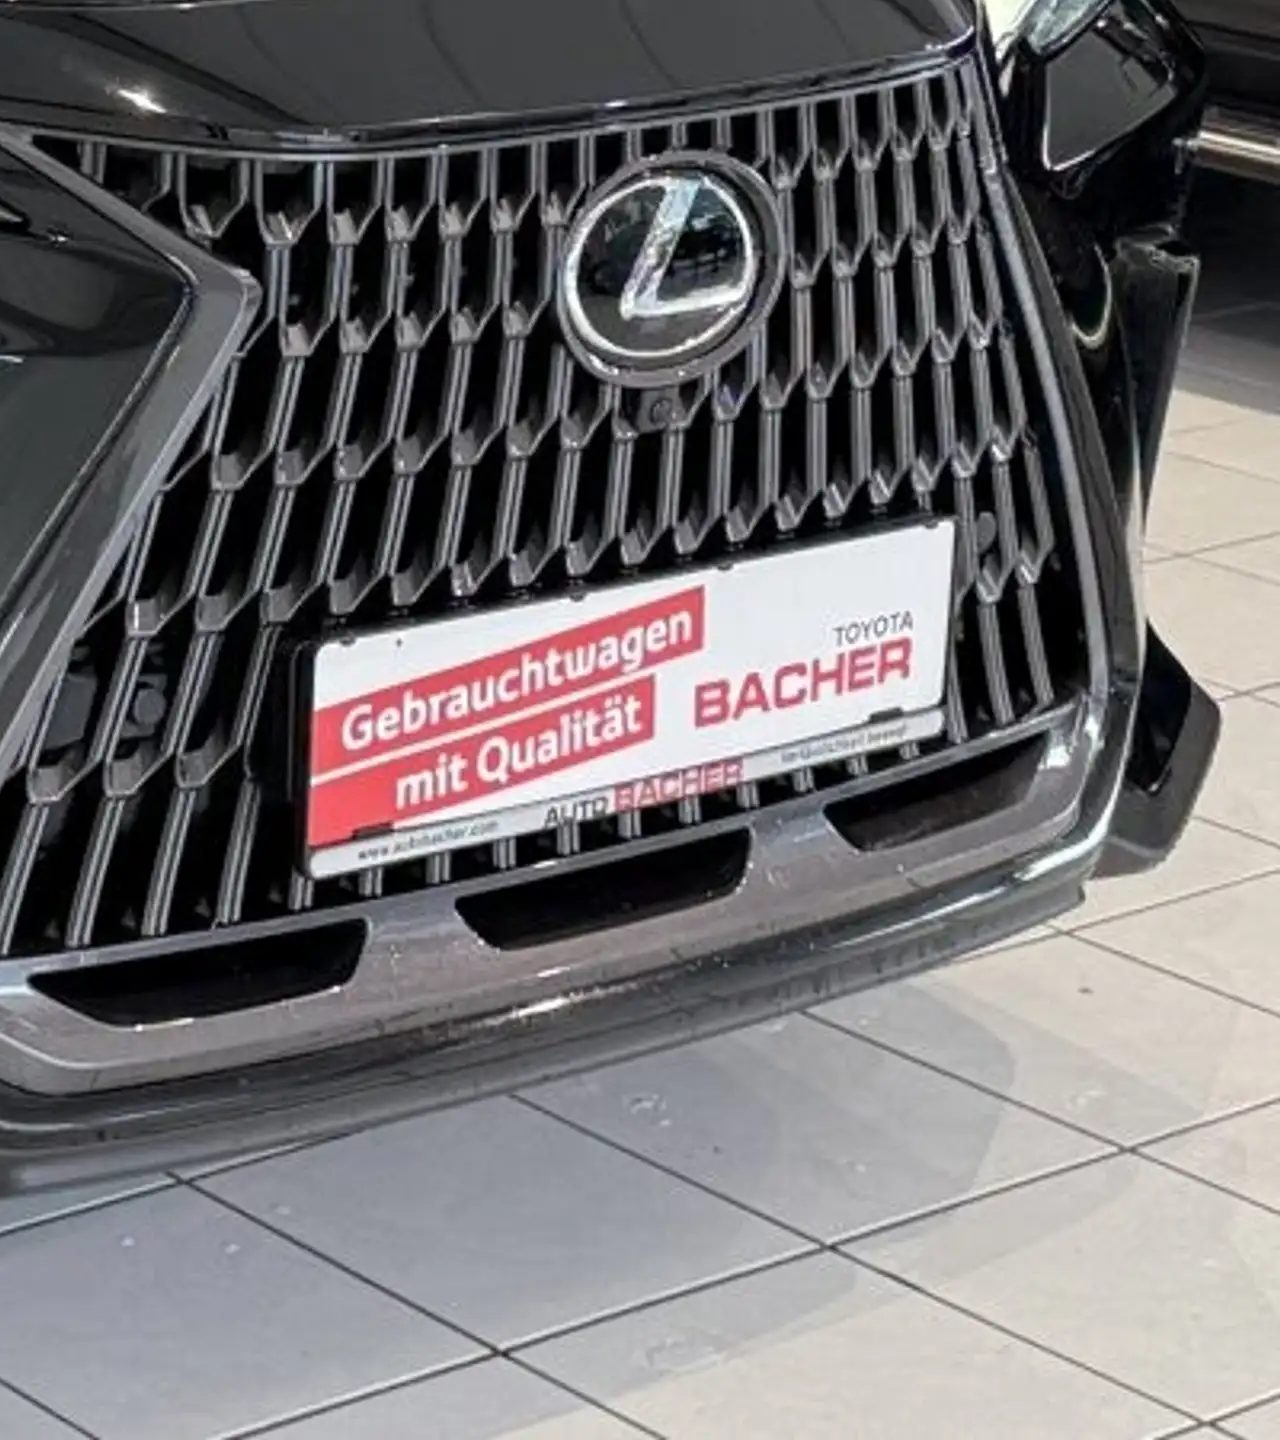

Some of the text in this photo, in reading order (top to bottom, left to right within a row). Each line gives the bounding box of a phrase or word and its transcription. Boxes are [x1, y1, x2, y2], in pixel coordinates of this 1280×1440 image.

[833, 610, 913, 646] TOYOTA
[341, 609, 692, 751] Gebrauchtwagen
[694, 637, 912, 728] BACHER
[395, 694, 642, 810] mit Qualität
[544, 761, 743, 828] AUTO BACHER
